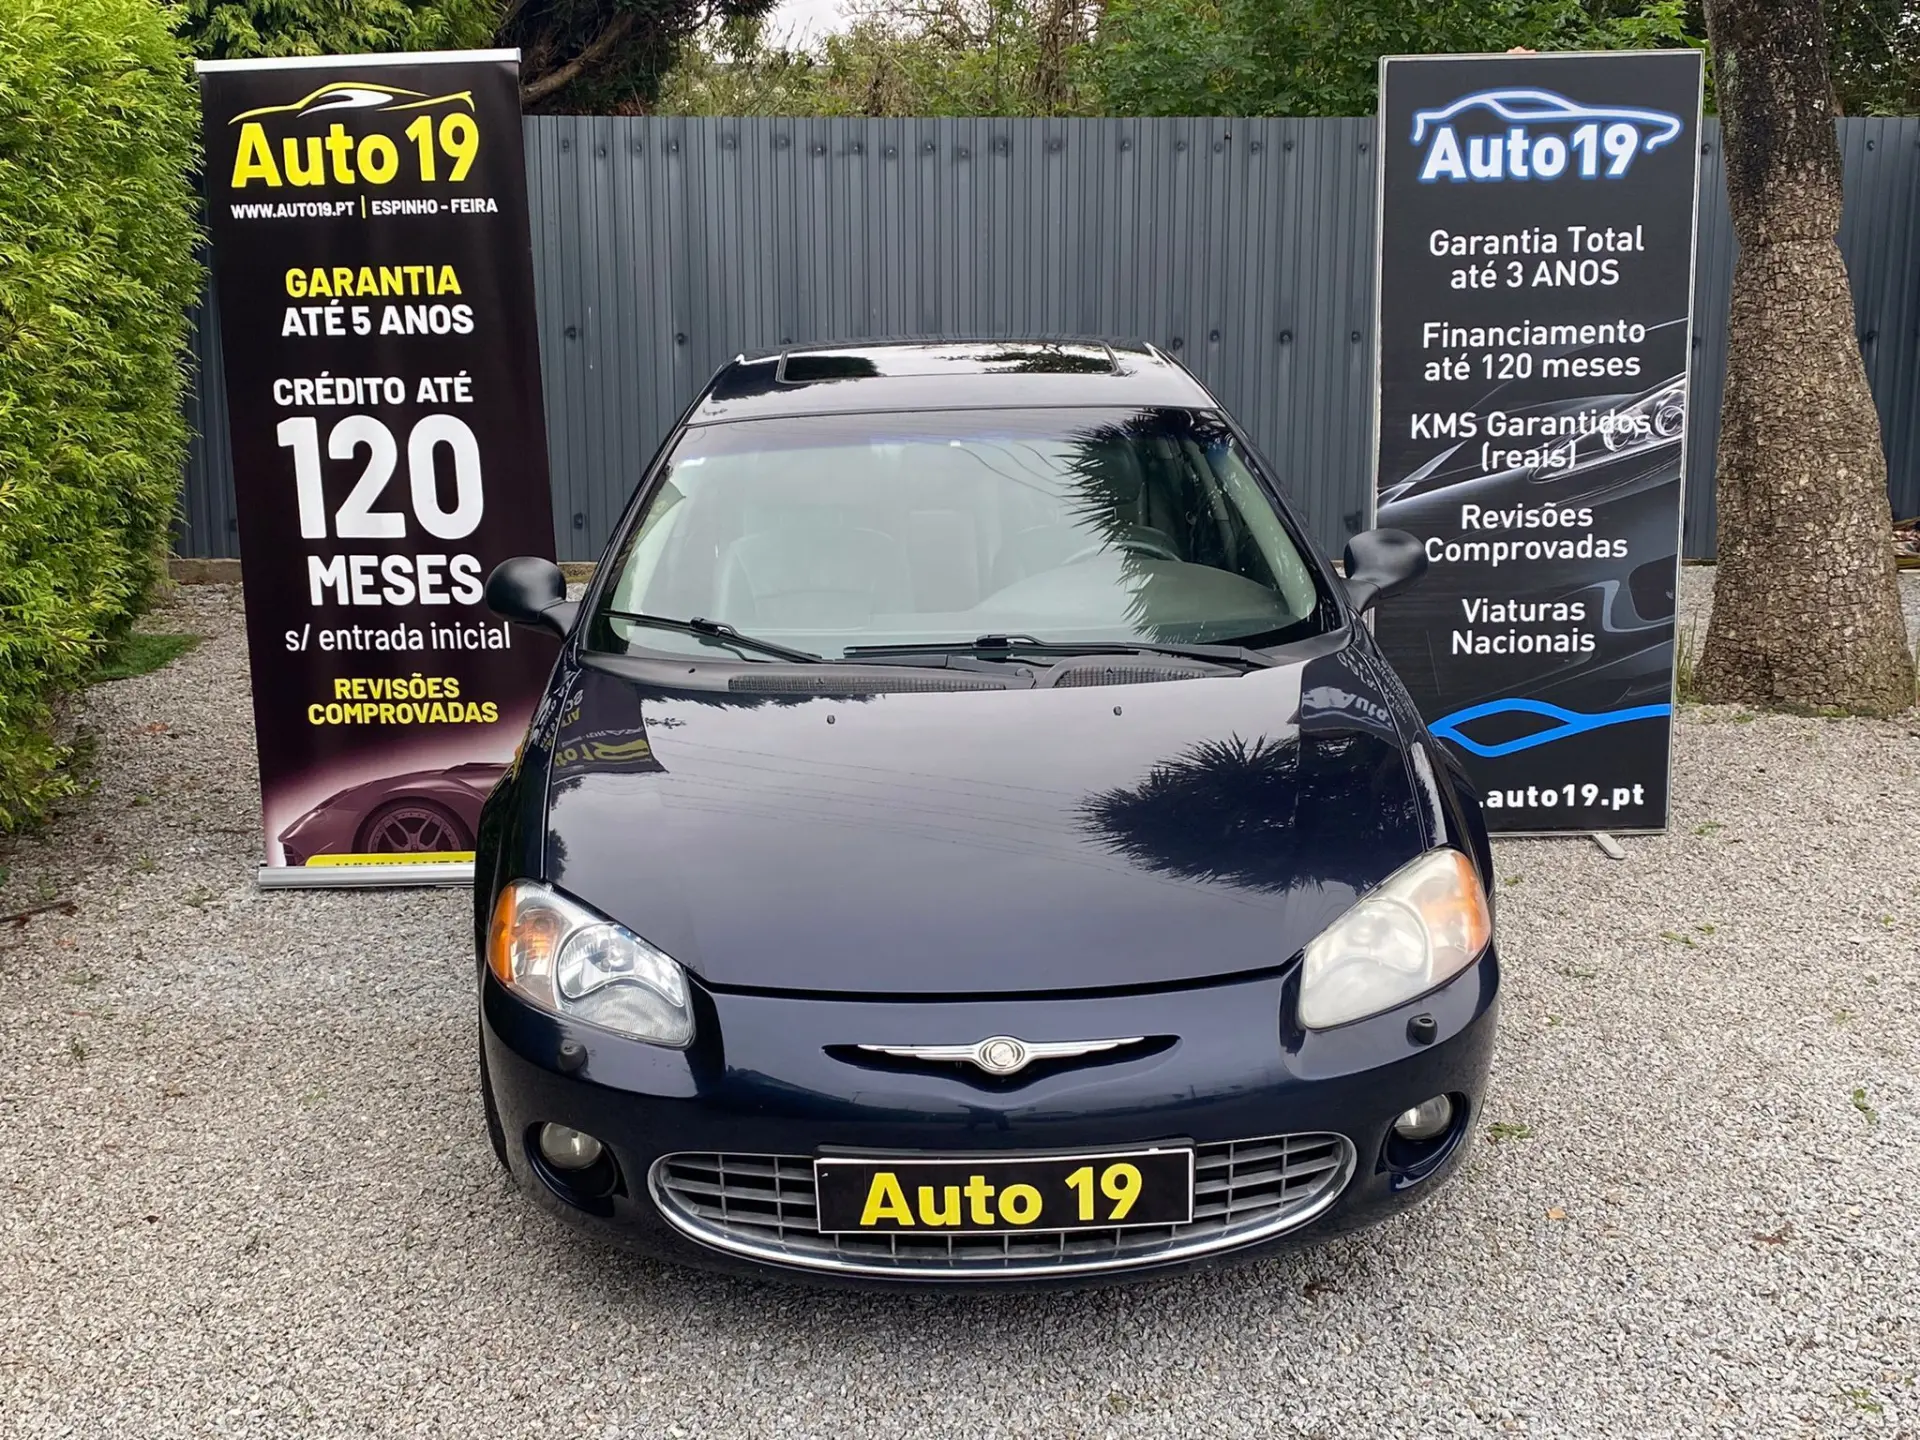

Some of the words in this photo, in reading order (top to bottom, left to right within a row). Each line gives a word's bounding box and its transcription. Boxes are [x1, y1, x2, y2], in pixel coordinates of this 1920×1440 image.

[231, 122, 398, 187] Auto
[405, 113, 479, 181] 19
[231, 202, 354, 218] WWW.AUTO19.PT
[372, 200, 437, 215] ESPINHO
[451, 198, 498, 213] FEIRA
[1430, 227, 1557, 256] Garantia
[1568, 225, 1644, 252] Total
[286, 265, 461, 297] GARANTIA
[1451, 261, 1497, 289] até
[1507, 261, 1523, 287] 3
[1532, 259, 1619, 287] ANOS
[282, 299, 345, 336] ATÉ
[352, 306, 371, 335] 5
[380, 304, 474, 334] ANOS
[1424, 320, 1646, 348] Financiamento
[1425, 353, 1470, 381] até
[1483, 353, 1532, 379] 120
[1543, 357, 1640, 378] meses
[274, 371, 405, 405] CRÉDITO
[417, 371, 473, 402] ATÉ
[1412, 412, 1477, 439] KMS
[1488, 409, 1651, 438] Garantidos
[1482, 440, 1577, 471] (reais)
[277, 414, 483, 539] 120
[1462, 502, 1593, 529] Revisões
[1425, 534, 1628, 567] Comprovadas
[308, 554, 483, 605] MESES
[1462, 598, 1585, 623] Viaturas
[286, 624, 310, 650] s/
[319, 623, 423, 650] entrada
[431, 622, 510, 649] inicial
[1453, 628, 1595, 654] Nacionais
[335, 673, 459, 699] REVISÕES
[308, 702, 498, 724] COMPROVADAS
[1479, 784, 1644, 810] .auto19.pt
[860, 1173, 1043, 1226] Auto
[1064, 1163, 1143, 1220] 19
